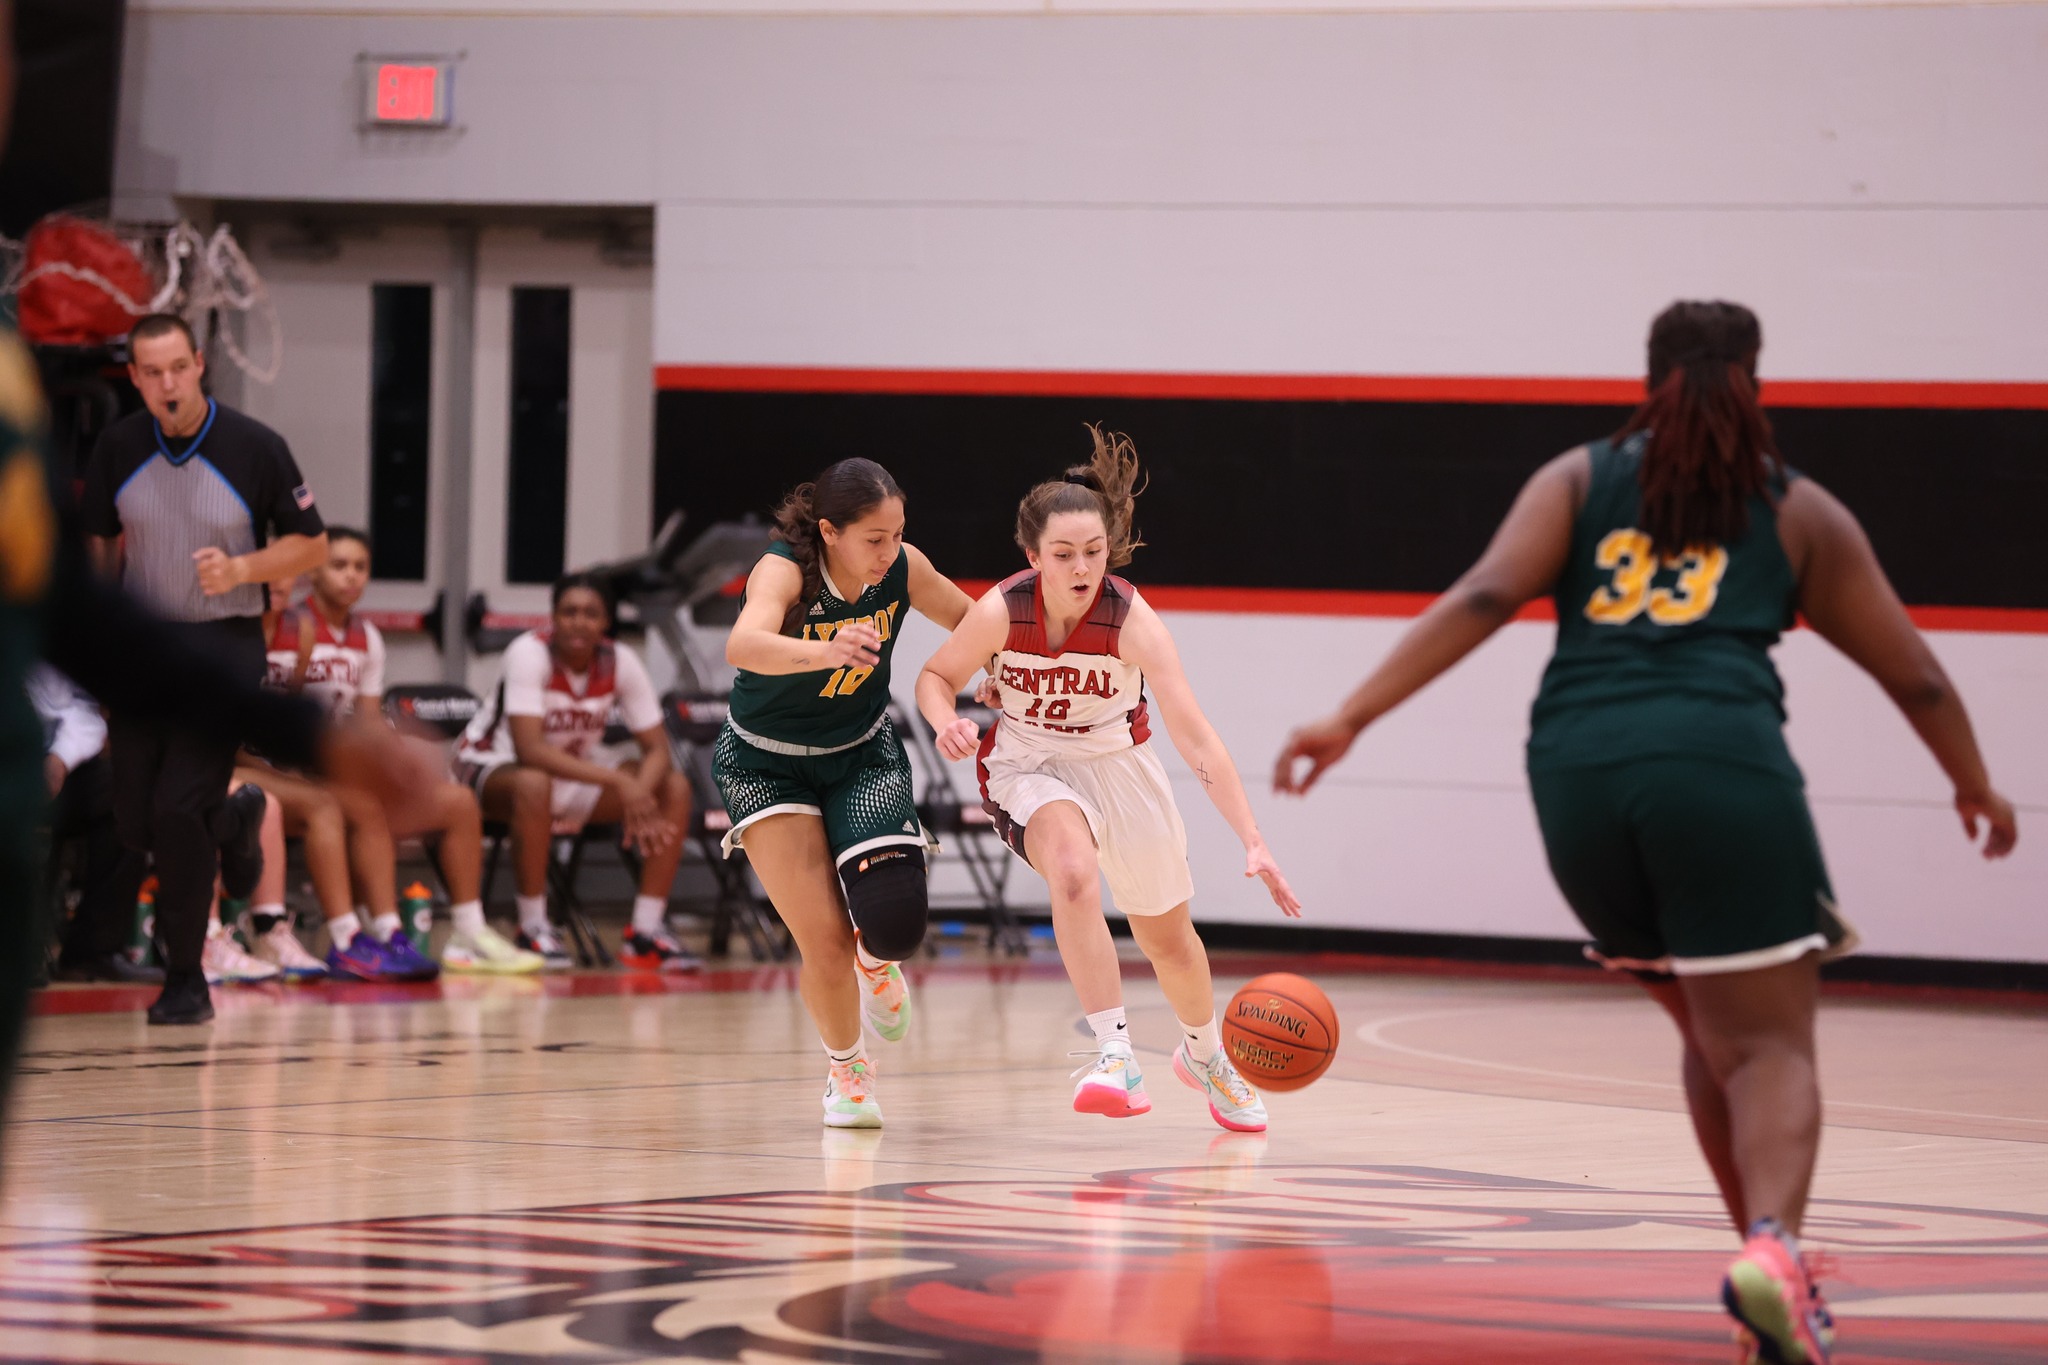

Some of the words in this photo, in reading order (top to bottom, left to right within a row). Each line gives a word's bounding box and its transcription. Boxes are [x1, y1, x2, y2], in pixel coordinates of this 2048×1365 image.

[1584, 528, 1729, 626] 33
[819, 664, 875, 698] 10
[1000, 664, 1119, 699] CENTRAL
[1235, 1000, 1308, 1040] SPALDING
[1231, 1034, 1294, 1063] LEGACY
